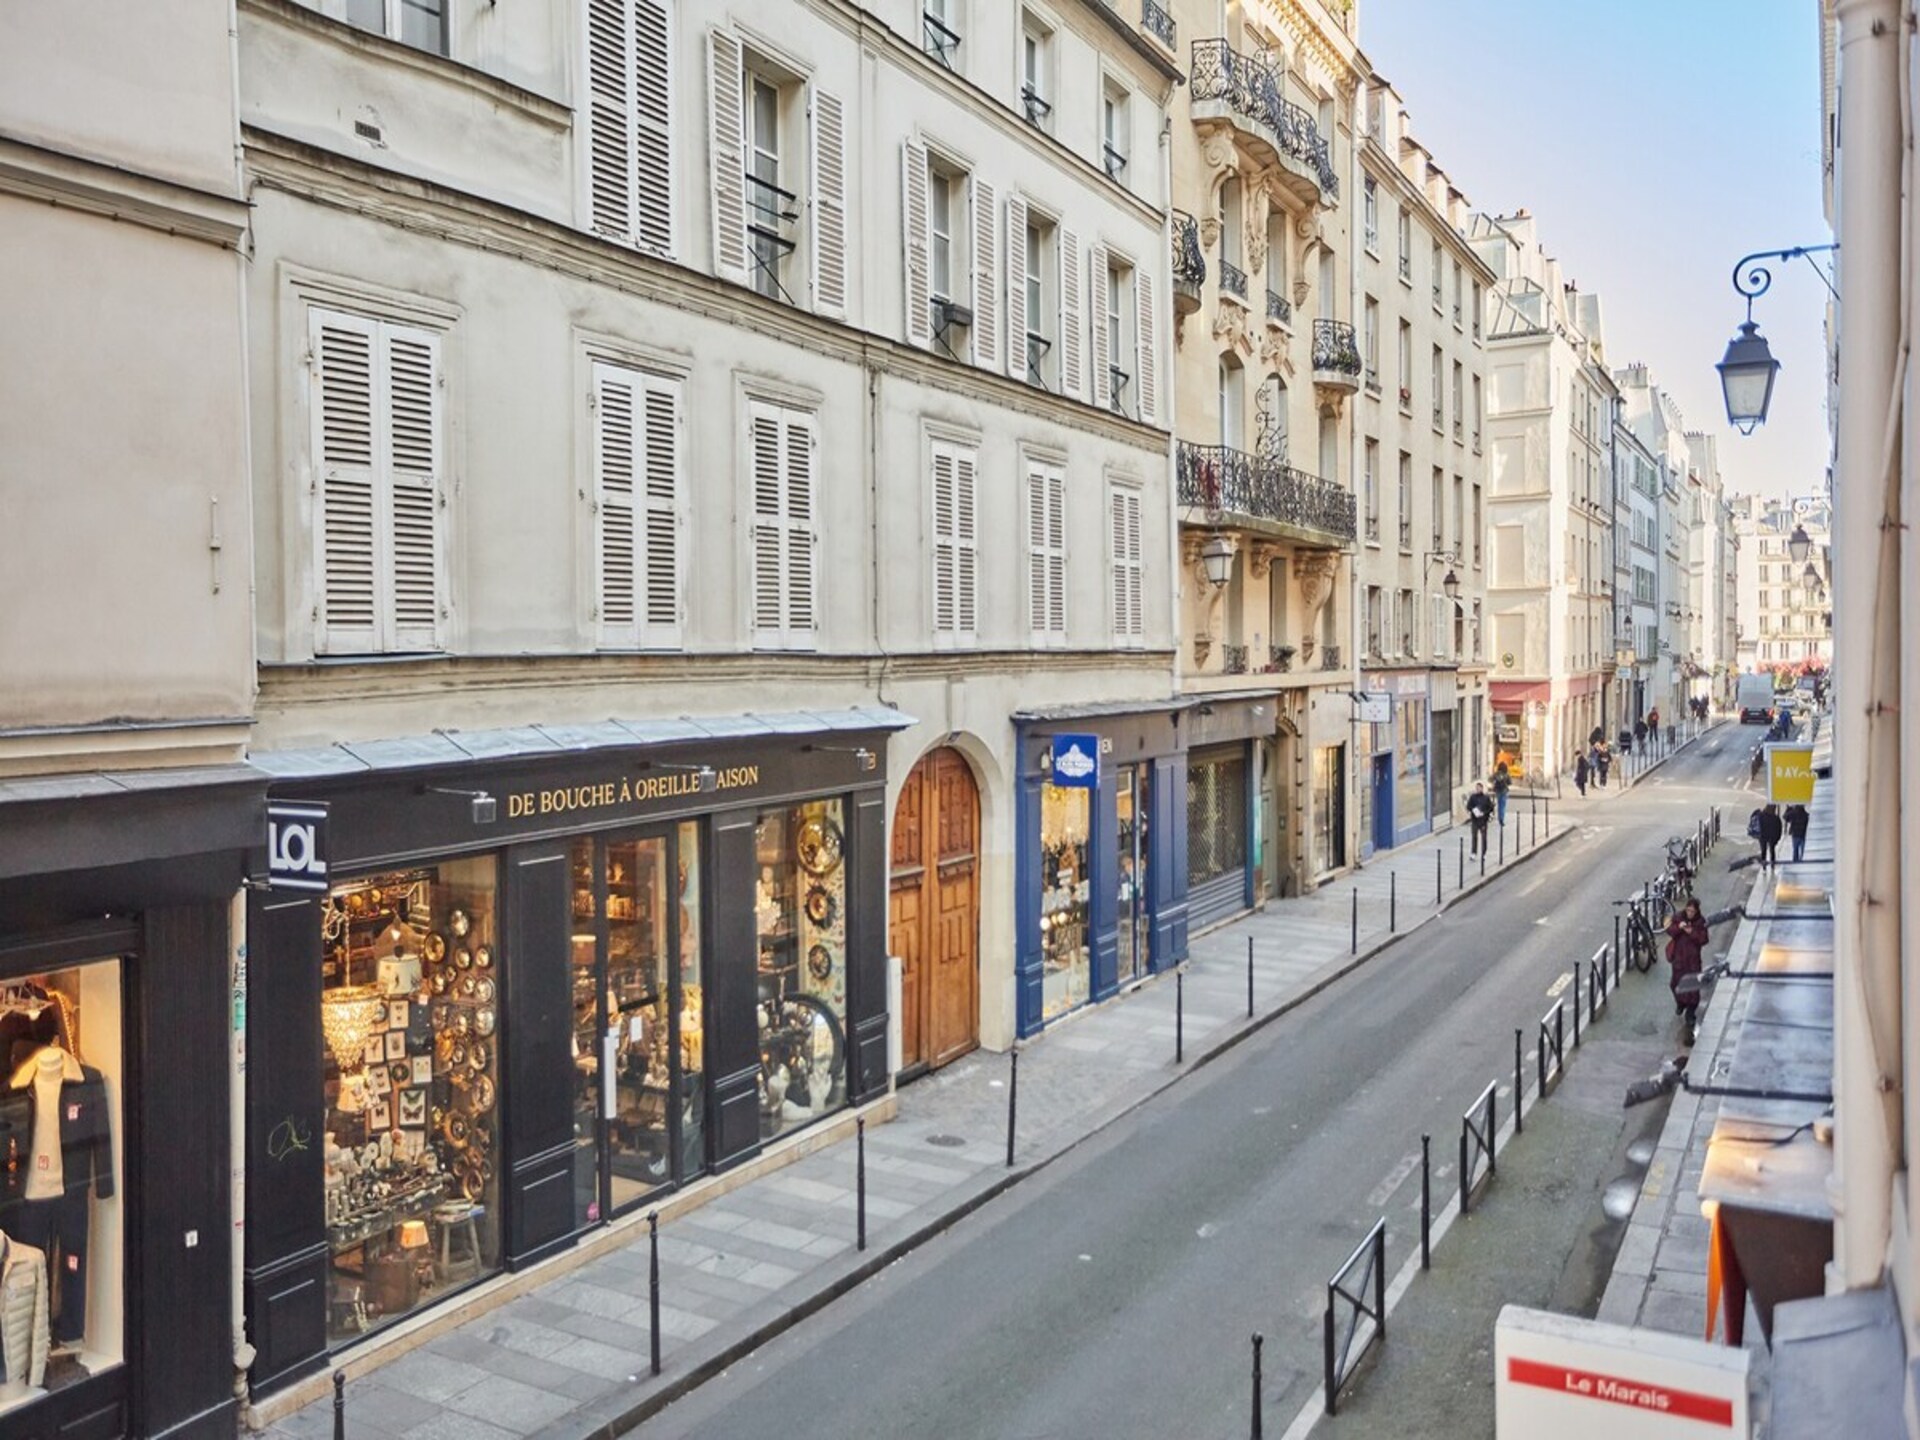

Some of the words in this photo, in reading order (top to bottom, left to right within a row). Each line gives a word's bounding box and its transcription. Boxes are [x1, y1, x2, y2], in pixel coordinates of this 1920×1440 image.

[509, 793, 535, 818] DE
[540, 783, 615, 813] BOUCHE
[619, 777, 632, 803] À
[635, 773, 700, 800] OREILLE
[716, 766, 759, 789] AISON
[268, 821, 327, 874] LOL
[1565, 1373, 1591, 1393] Le
[1597, 1378, 1671, 1410] Marais
